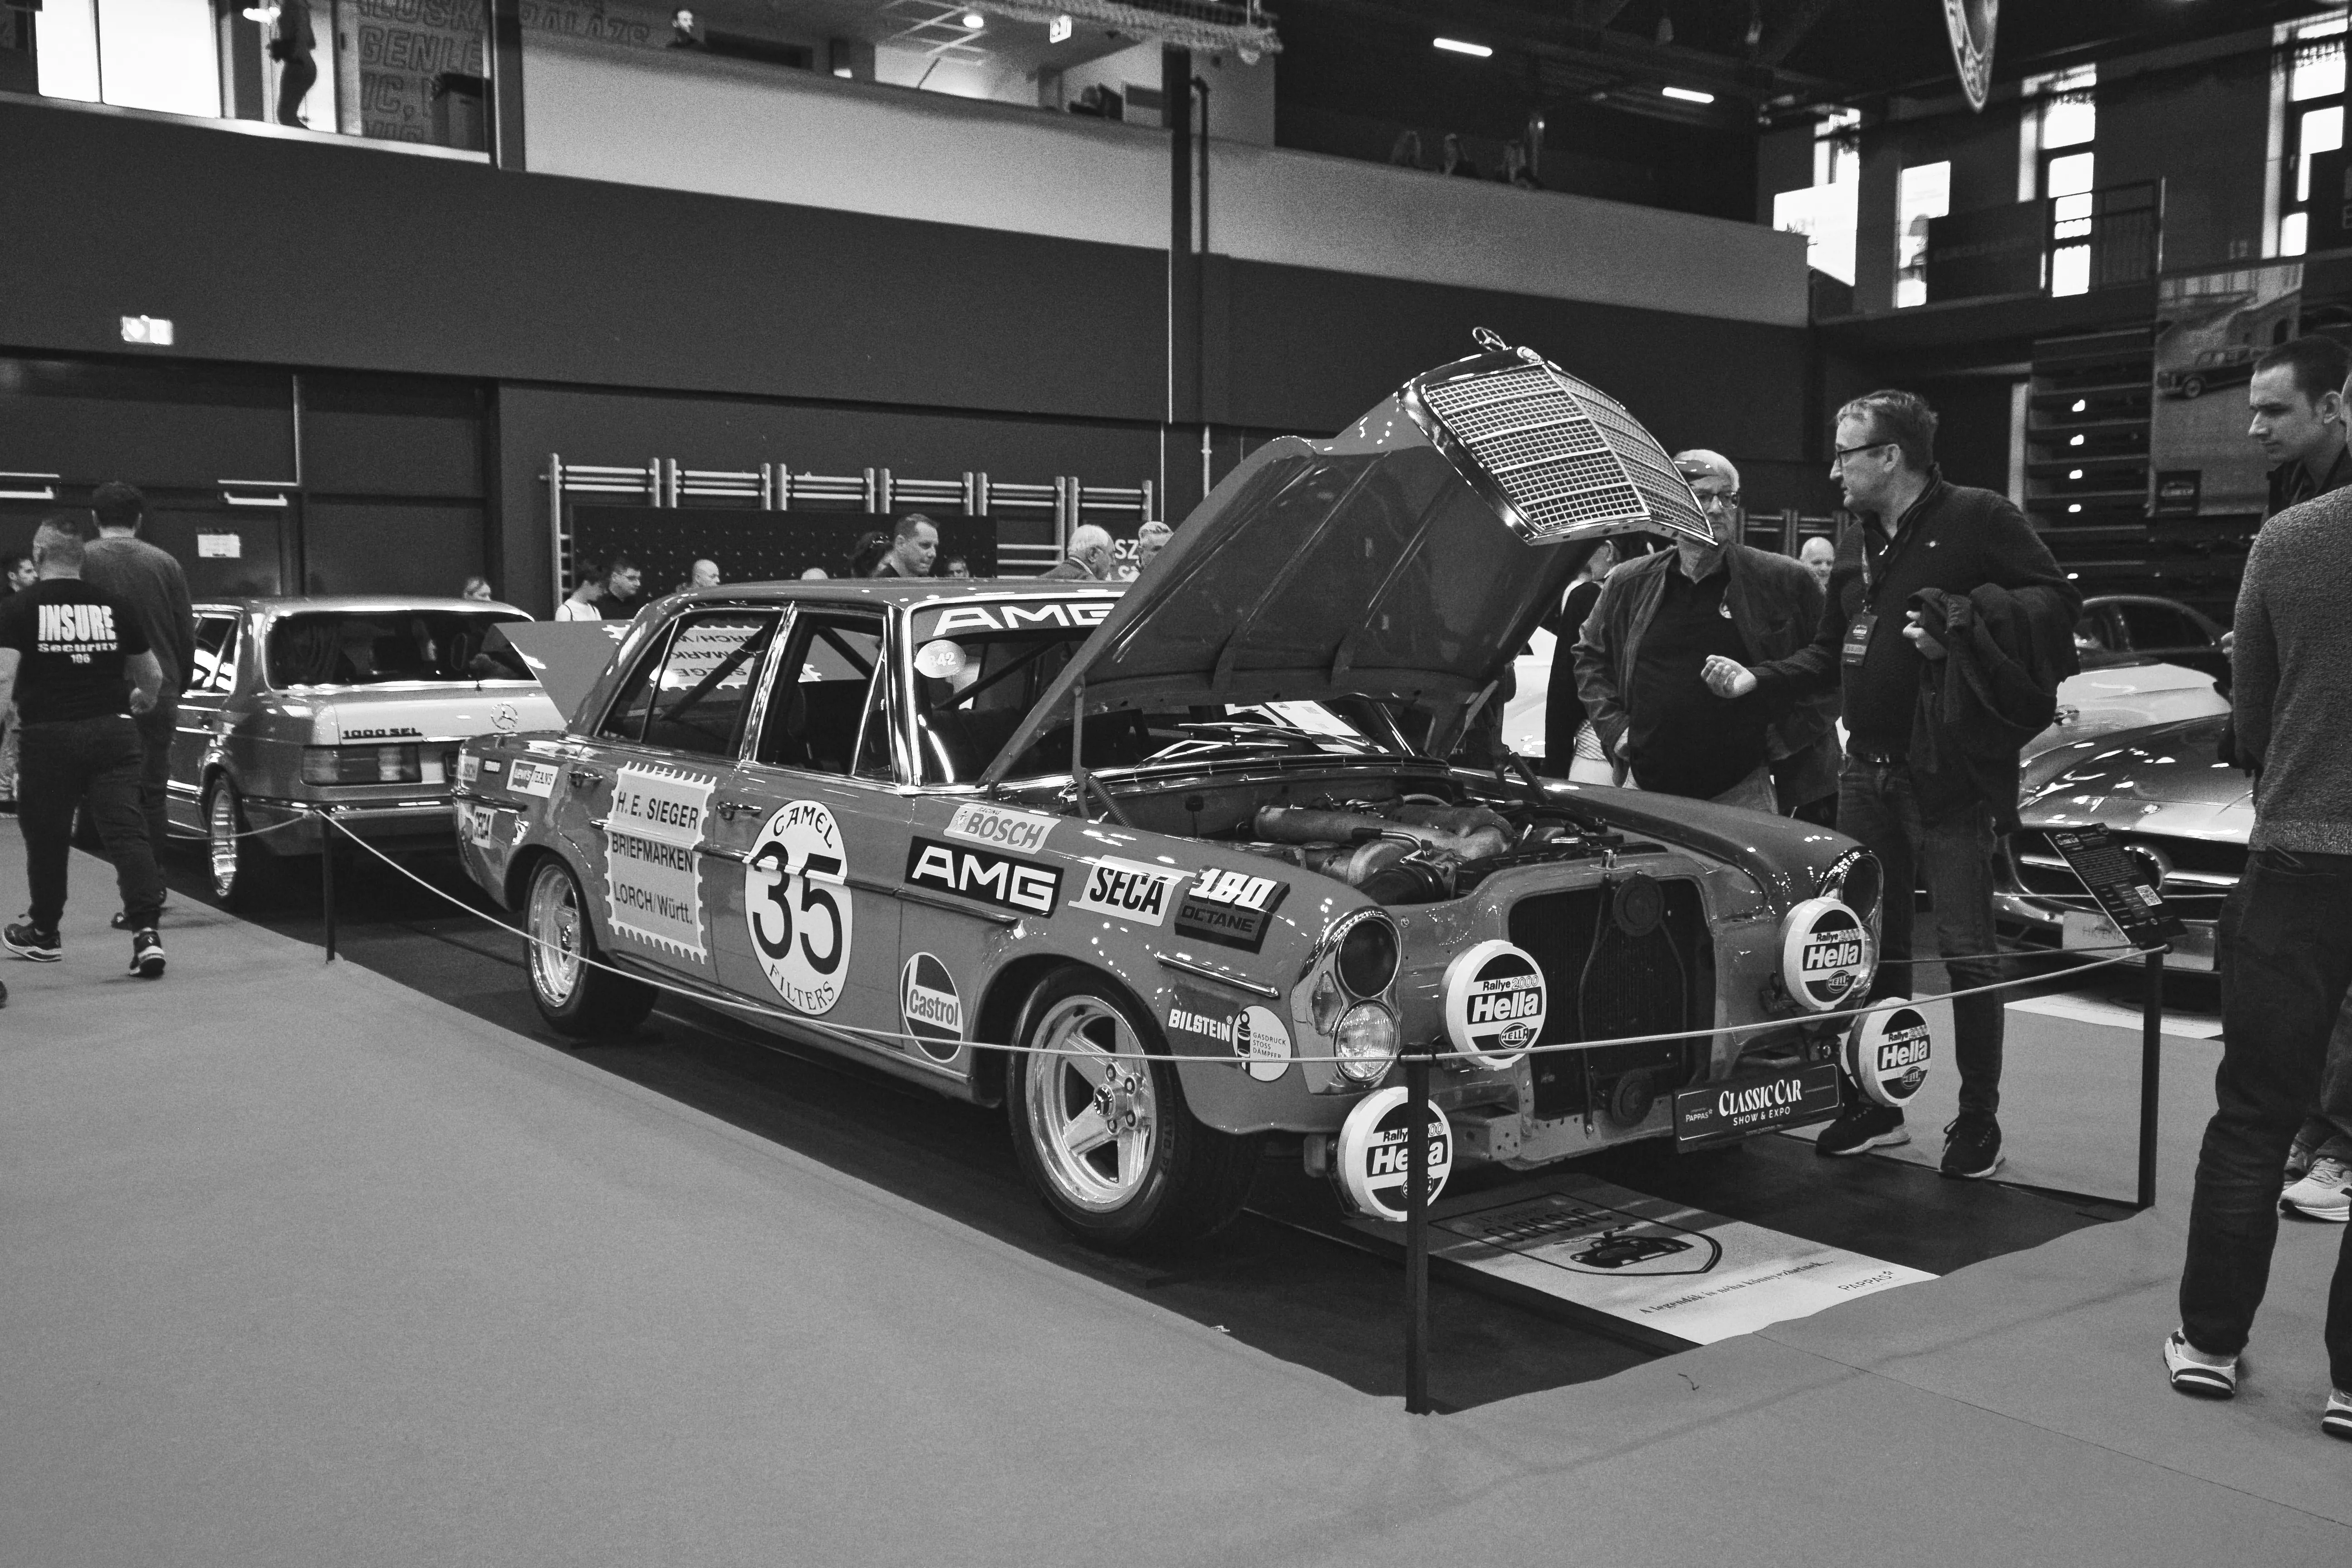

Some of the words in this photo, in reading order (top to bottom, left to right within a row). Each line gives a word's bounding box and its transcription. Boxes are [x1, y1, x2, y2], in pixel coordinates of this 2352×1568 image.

[38, 604, 116, 641] INSURE
[932, 603, 1114, 637] AMG
[37, 642, 118, 652] Security
[343, 729, 385, 740] 1000
[389, 727, 422, 737] SEL
[647, 798, 699, 830] SIEGER
[773, 806, 832, 849] CAMEL
[964, 812, 1045, 849] BOSCH
[612, 833, 693, 873] BRIEFMARKEN
[911, 846, 1056, 911] AMG
[1188, 868, 1277, 908] 180
[751, 841, 843, 975] 35
[1181, 905, 1255, 933] OCTANE
[1816, 933, 1838, 943] Rallye
[1806, 943, 1859, 969] Hella
[769, 962, 834, 1010] FILTERS
[1483, 980, 1511, 991] Rallye
[1511, 975, 1539, 990] 2000
[909, 989, 959, 1026] Castrol
[1472, 991, 1539, 1022] Hella
[1253, 1032, 1286, 1046] GASDRUCK
[1253, 1039, 1271, 1050] STOSS
[1502, 1027, 1529, 1039] HELLA
[1882, 1039, 1928, 1069] Hella
[1686, 1113, 1709, 1122] PAPPAS
[1733, 1113, 1758, 1126] SHOW
[1760, 1111, 1766, 1120] &
[1769, 1106, 1791, 1119] EXPO
[1383, 1129, 1407, 1142] Rally
[1372, 1142, 1444, 1175] Hea
[1838, 1275, 1893, 1291] PAPPAS
